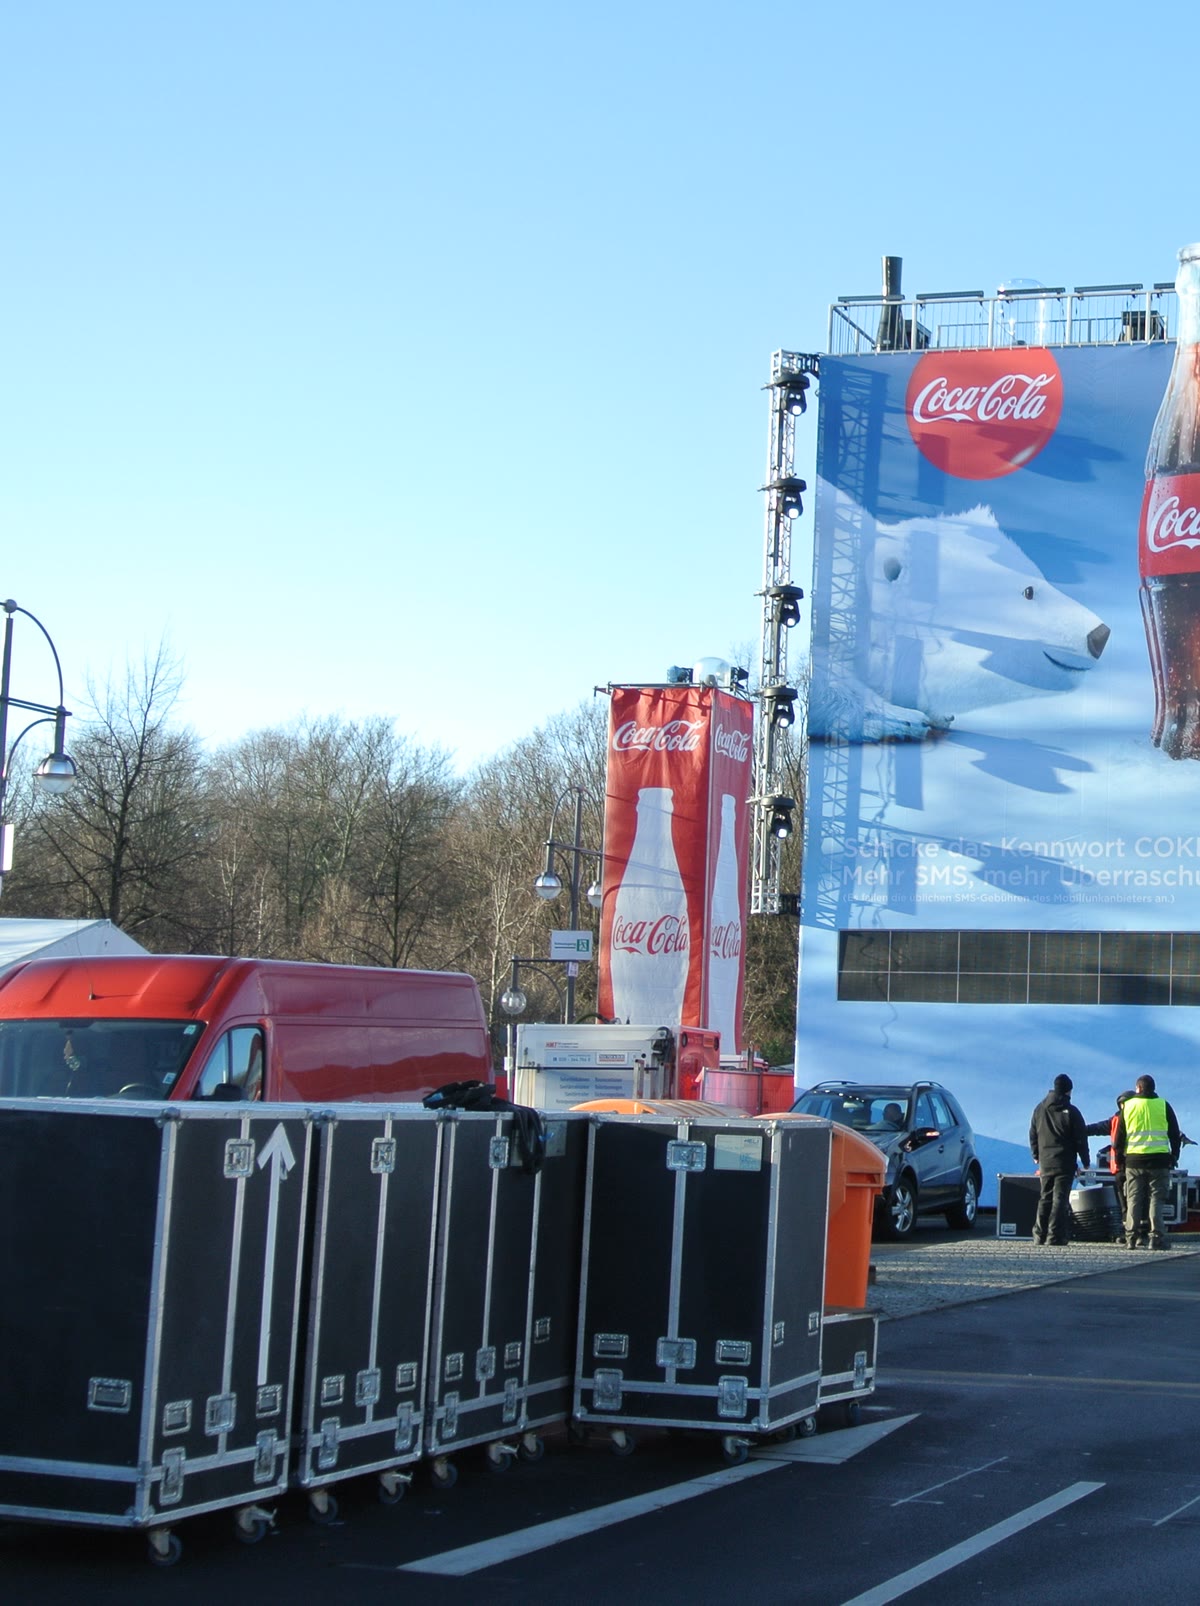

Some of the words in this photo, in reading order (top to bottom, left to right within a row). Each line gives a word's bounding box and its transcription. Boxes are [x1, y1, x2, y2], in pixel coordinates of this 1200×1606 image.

[913, 373, 1056, 424] Coca-Cola
[612, 720, 705, 752] Coca-Cola
[715, 723, 752, 763] Coca-Cola
[843, 837, 939, 858] Schicke
[948, 837, 991, 858] das
[1001, 837, 1125, 858] Kennwort
[843, 865, 904, 886] Mehr
[915, 865, 974, 889] SMS,
[984, 865, 1048, 887] mehr
[891, 893, 907, 903] die
[1032, 893, 1051, 903] des
[1053, 893, 1152, 904] Mobilfunkanbieters
[613, 914, 690, 957] Coca-Cola
